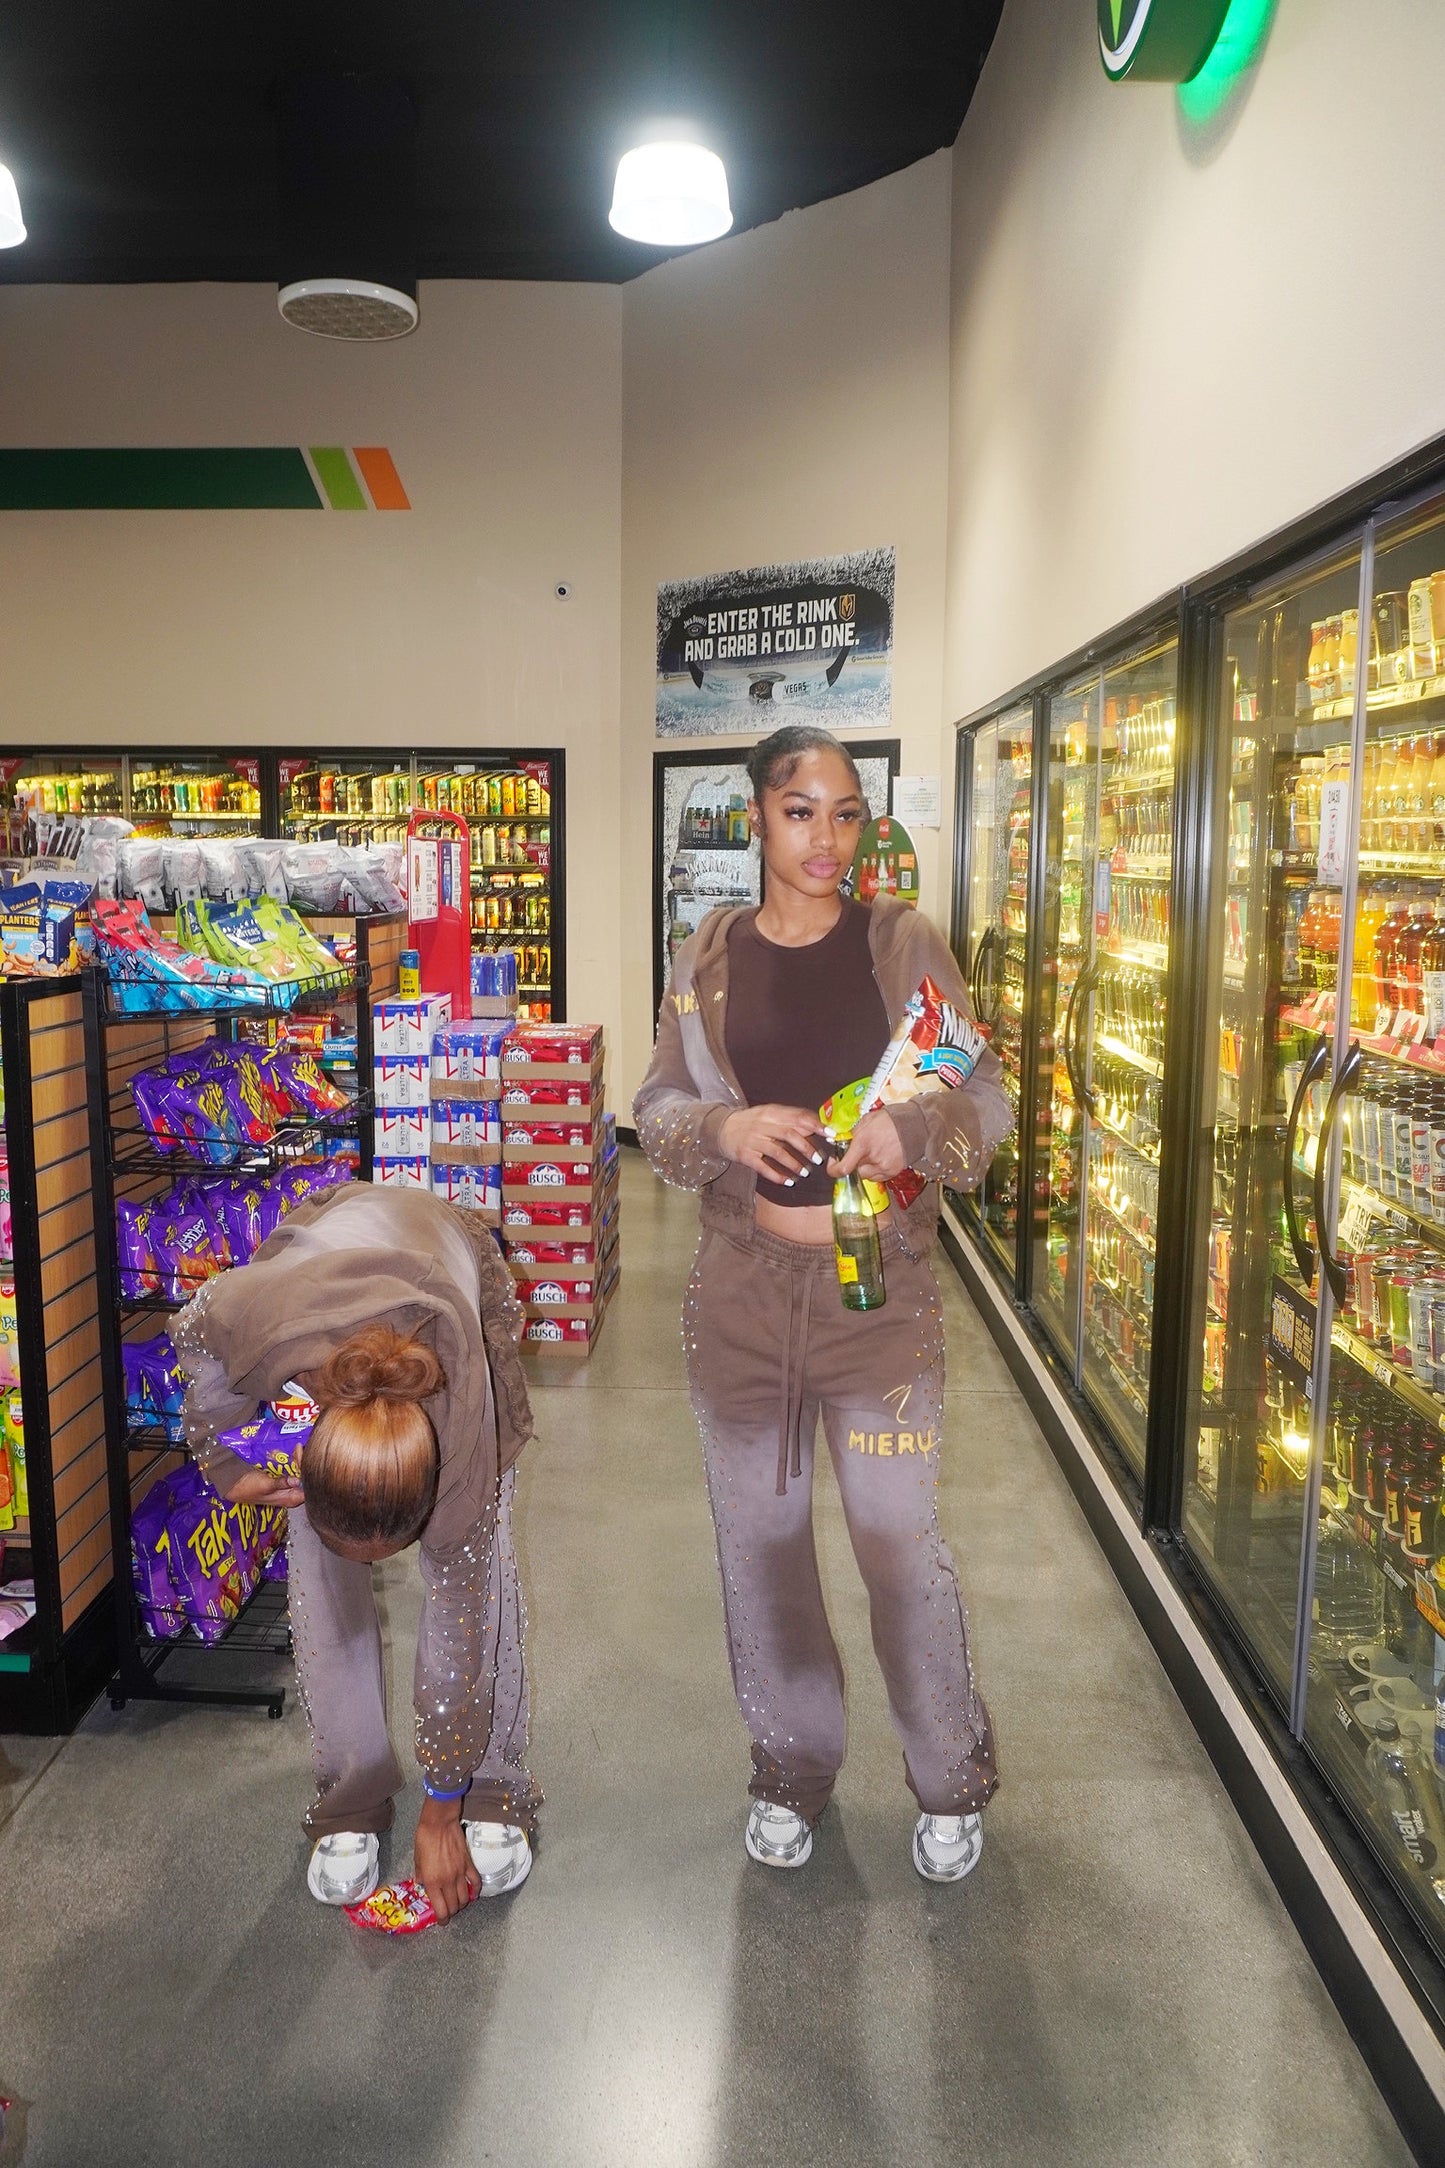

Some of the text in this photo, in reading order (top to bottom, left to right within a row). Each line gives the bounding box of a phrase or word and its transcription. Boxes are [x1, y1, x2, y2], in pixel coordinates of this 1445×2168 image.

[708, 597, 838, 634] ENTER THE RINK
[685, 622, 860, 662] AND GRAB A COLD ONE.
[784, 682, 807, 695] VEGAS
[0, 914, 40, 926] PLANTERS
[504, 1054, 531, 1063] BUSCH
[504, 1095, 531, 1104] BUSCH
[506, 1136, 533, 1145] BUSCH
[529, 1173, 565, 1185] BUSCH
[505, 1216, 532, 1225] BUSCH
[1355, 1205, 1371, 1229] TRY
[1349, 1228, 1366, 1252] NEW
[509, 1255, 535, 1264] BUSCH
[531, 1292, 567, 1303] BUSCH
[1, 1316, 18, 1330] Pe
[527, 1328, 563, 1340] BUSCH
[1411, 1809, 1425, 1835] water
